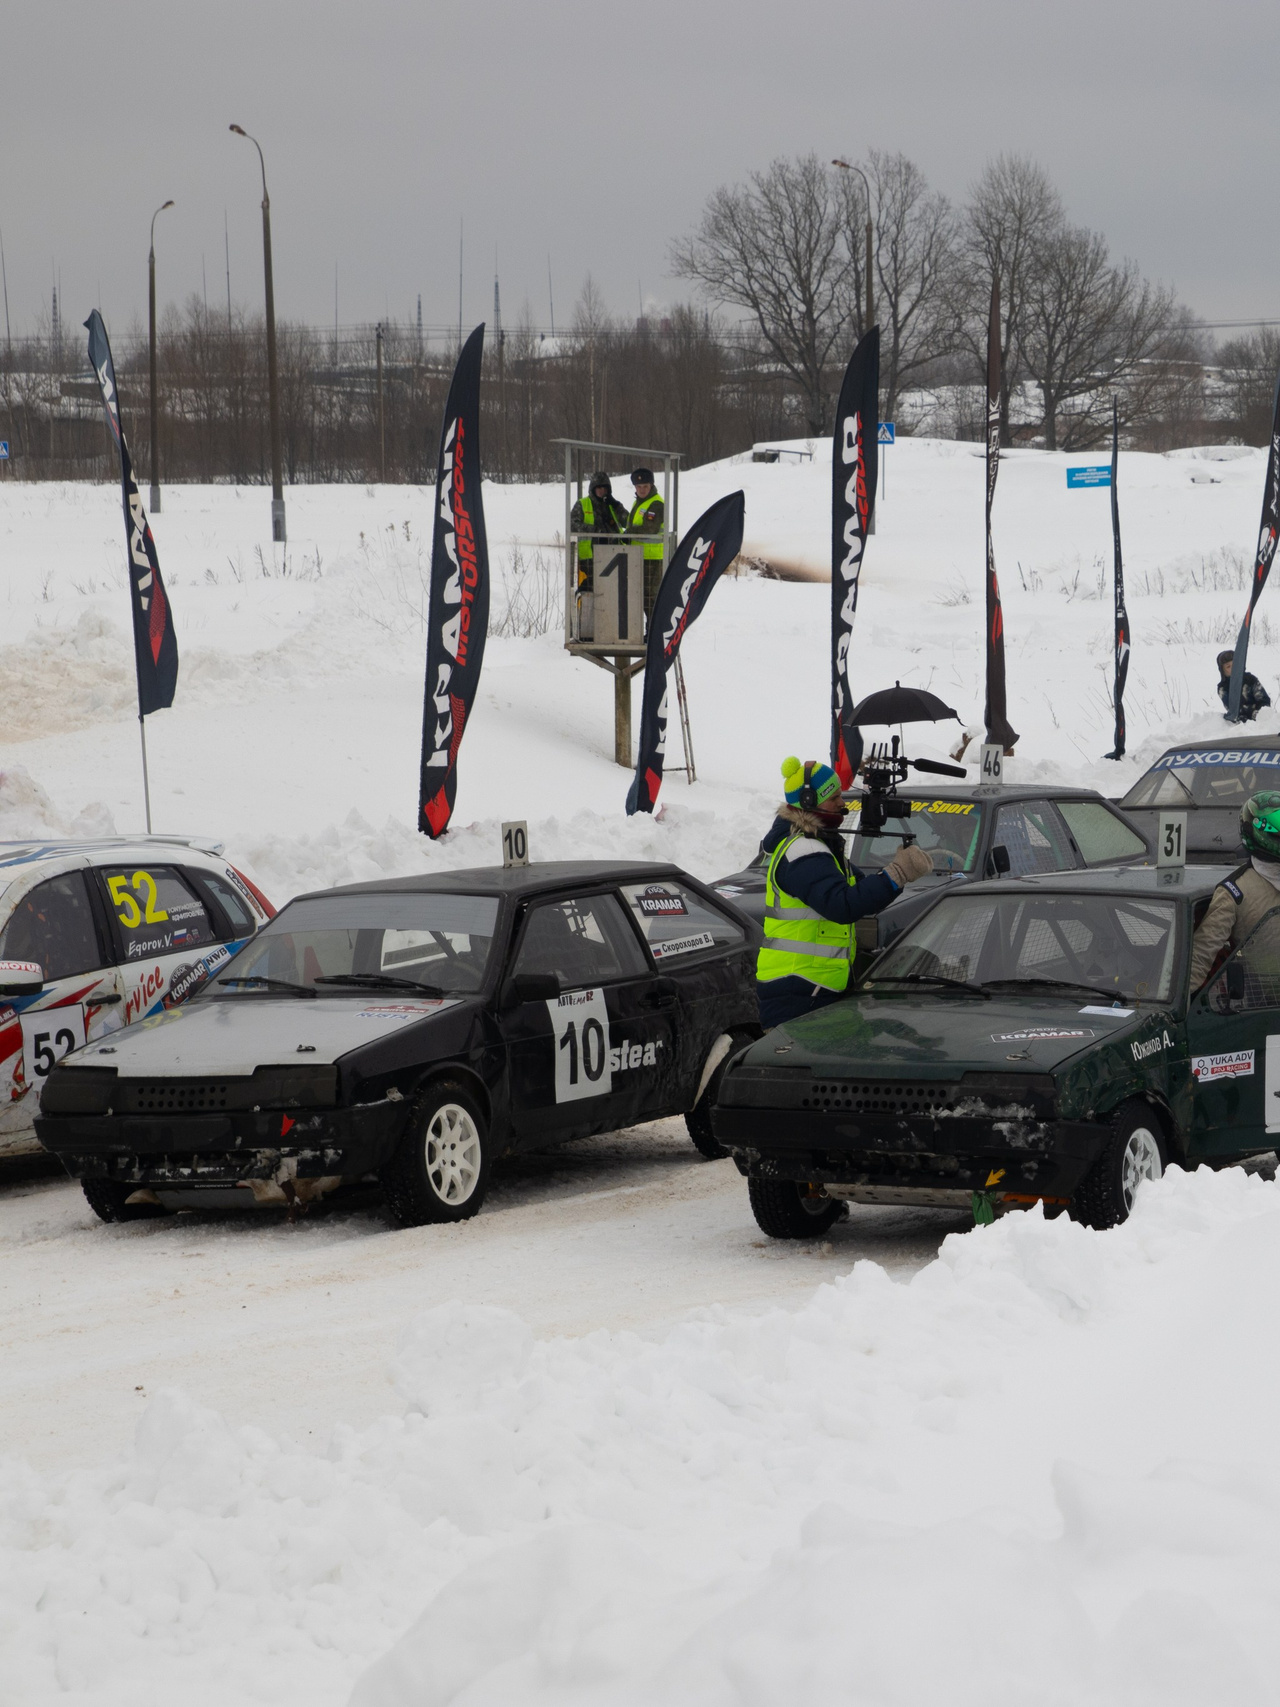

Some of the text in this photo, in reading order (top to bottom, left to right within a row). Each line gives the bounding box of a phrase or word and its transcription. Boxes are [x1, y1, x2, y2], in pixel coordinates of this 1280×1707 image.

[599, 552, 628, 640] 1
[983, 750, 1001, 777] 46
[928, 800, 975, 815] Sport
[504, 828, 526, 860] 10
[1164, 823, 1182, 858] 31
[107, 870, 169, 929] 52
[641, 898, 683, 911] KRAMAR
[205, 947, 227, 967] NWB
[662, 936, 704, 953] Скороходов
[171, 960, 206, 1001] KRAMAR
[1000, 1030, 1085, 1041] KRAMAR
[560, 1017, 606, 1085] 10
[1130, 1037, 1162, 1061] Южаков
[1209, 1051, 1254, 1066] YUKA ADV
